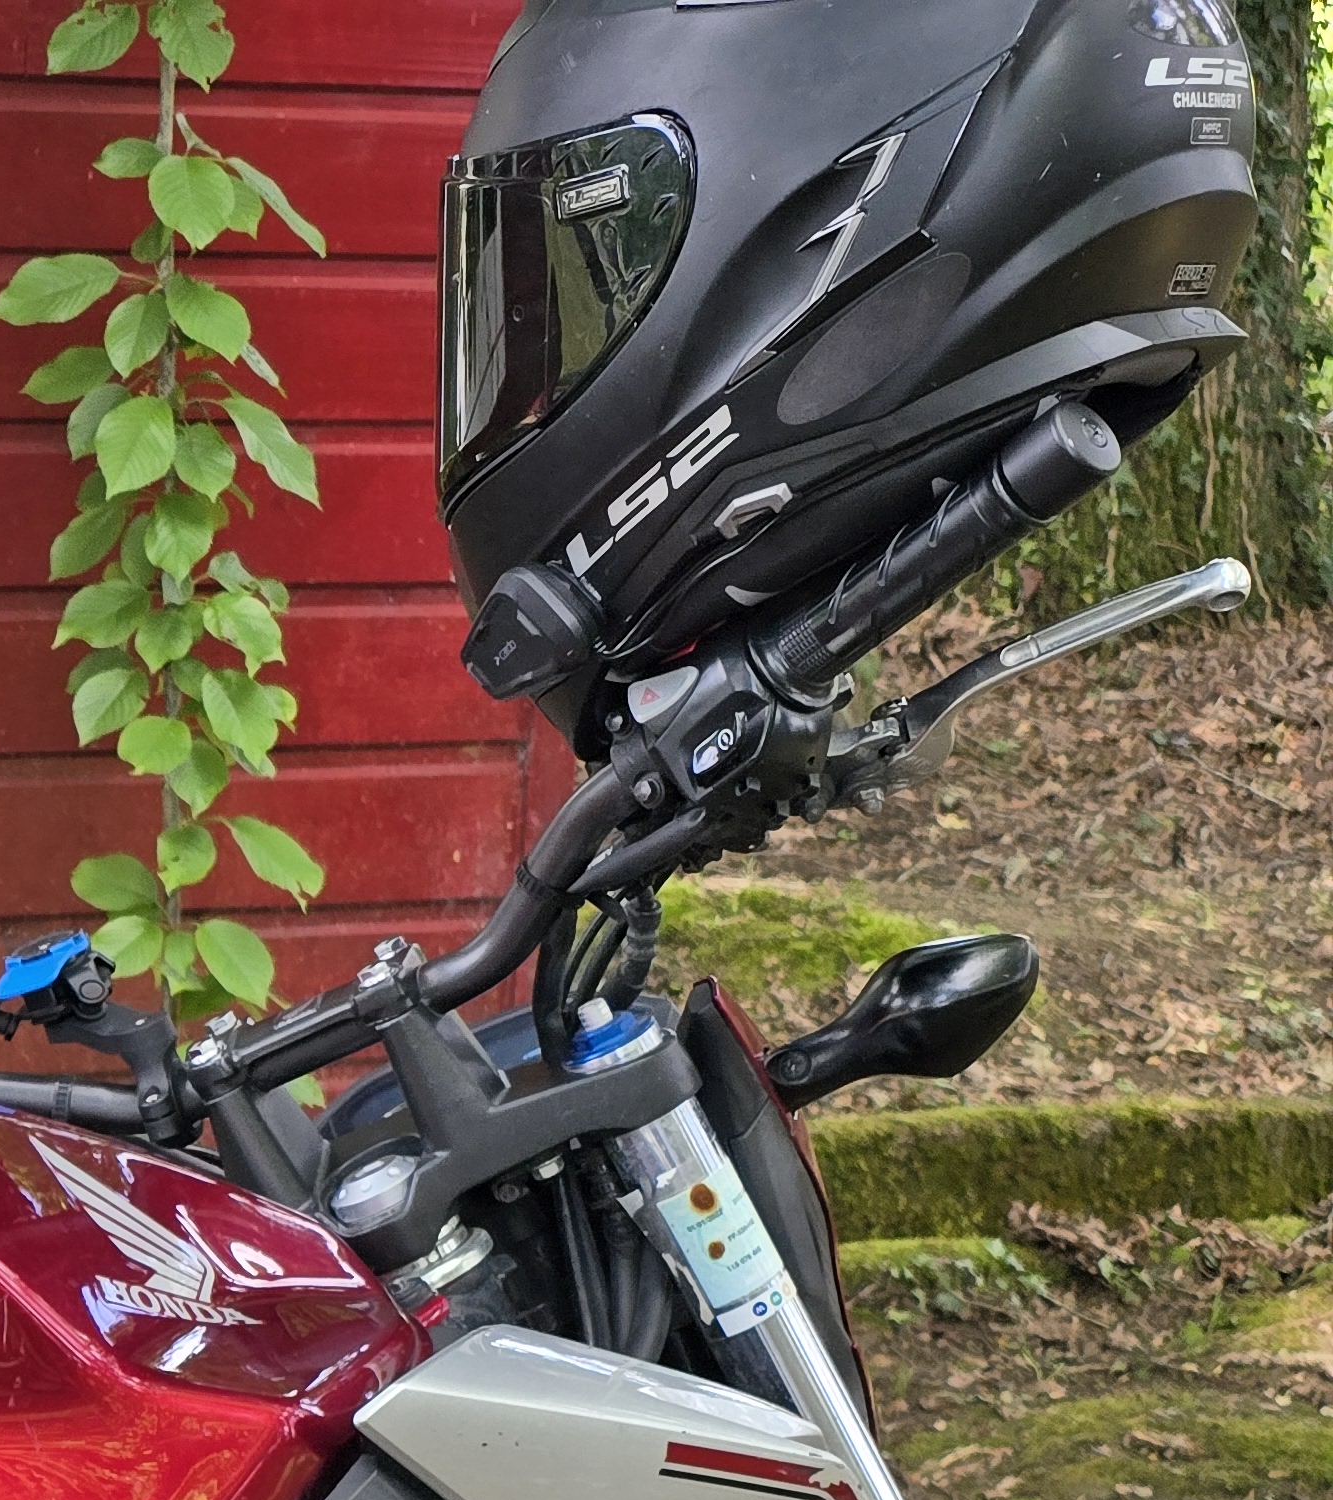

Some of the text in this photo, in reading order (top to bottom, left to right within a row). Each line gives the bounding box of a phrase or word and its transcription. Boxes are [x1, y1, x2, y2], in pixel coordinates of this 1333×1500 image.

[1145, 57, 1249, 89] LS2
[1173, 91, 1236, 109] CHALLENGER
[566, 404, 740, 578] LS2
[95, 1275, 264, 1326] HONDA
